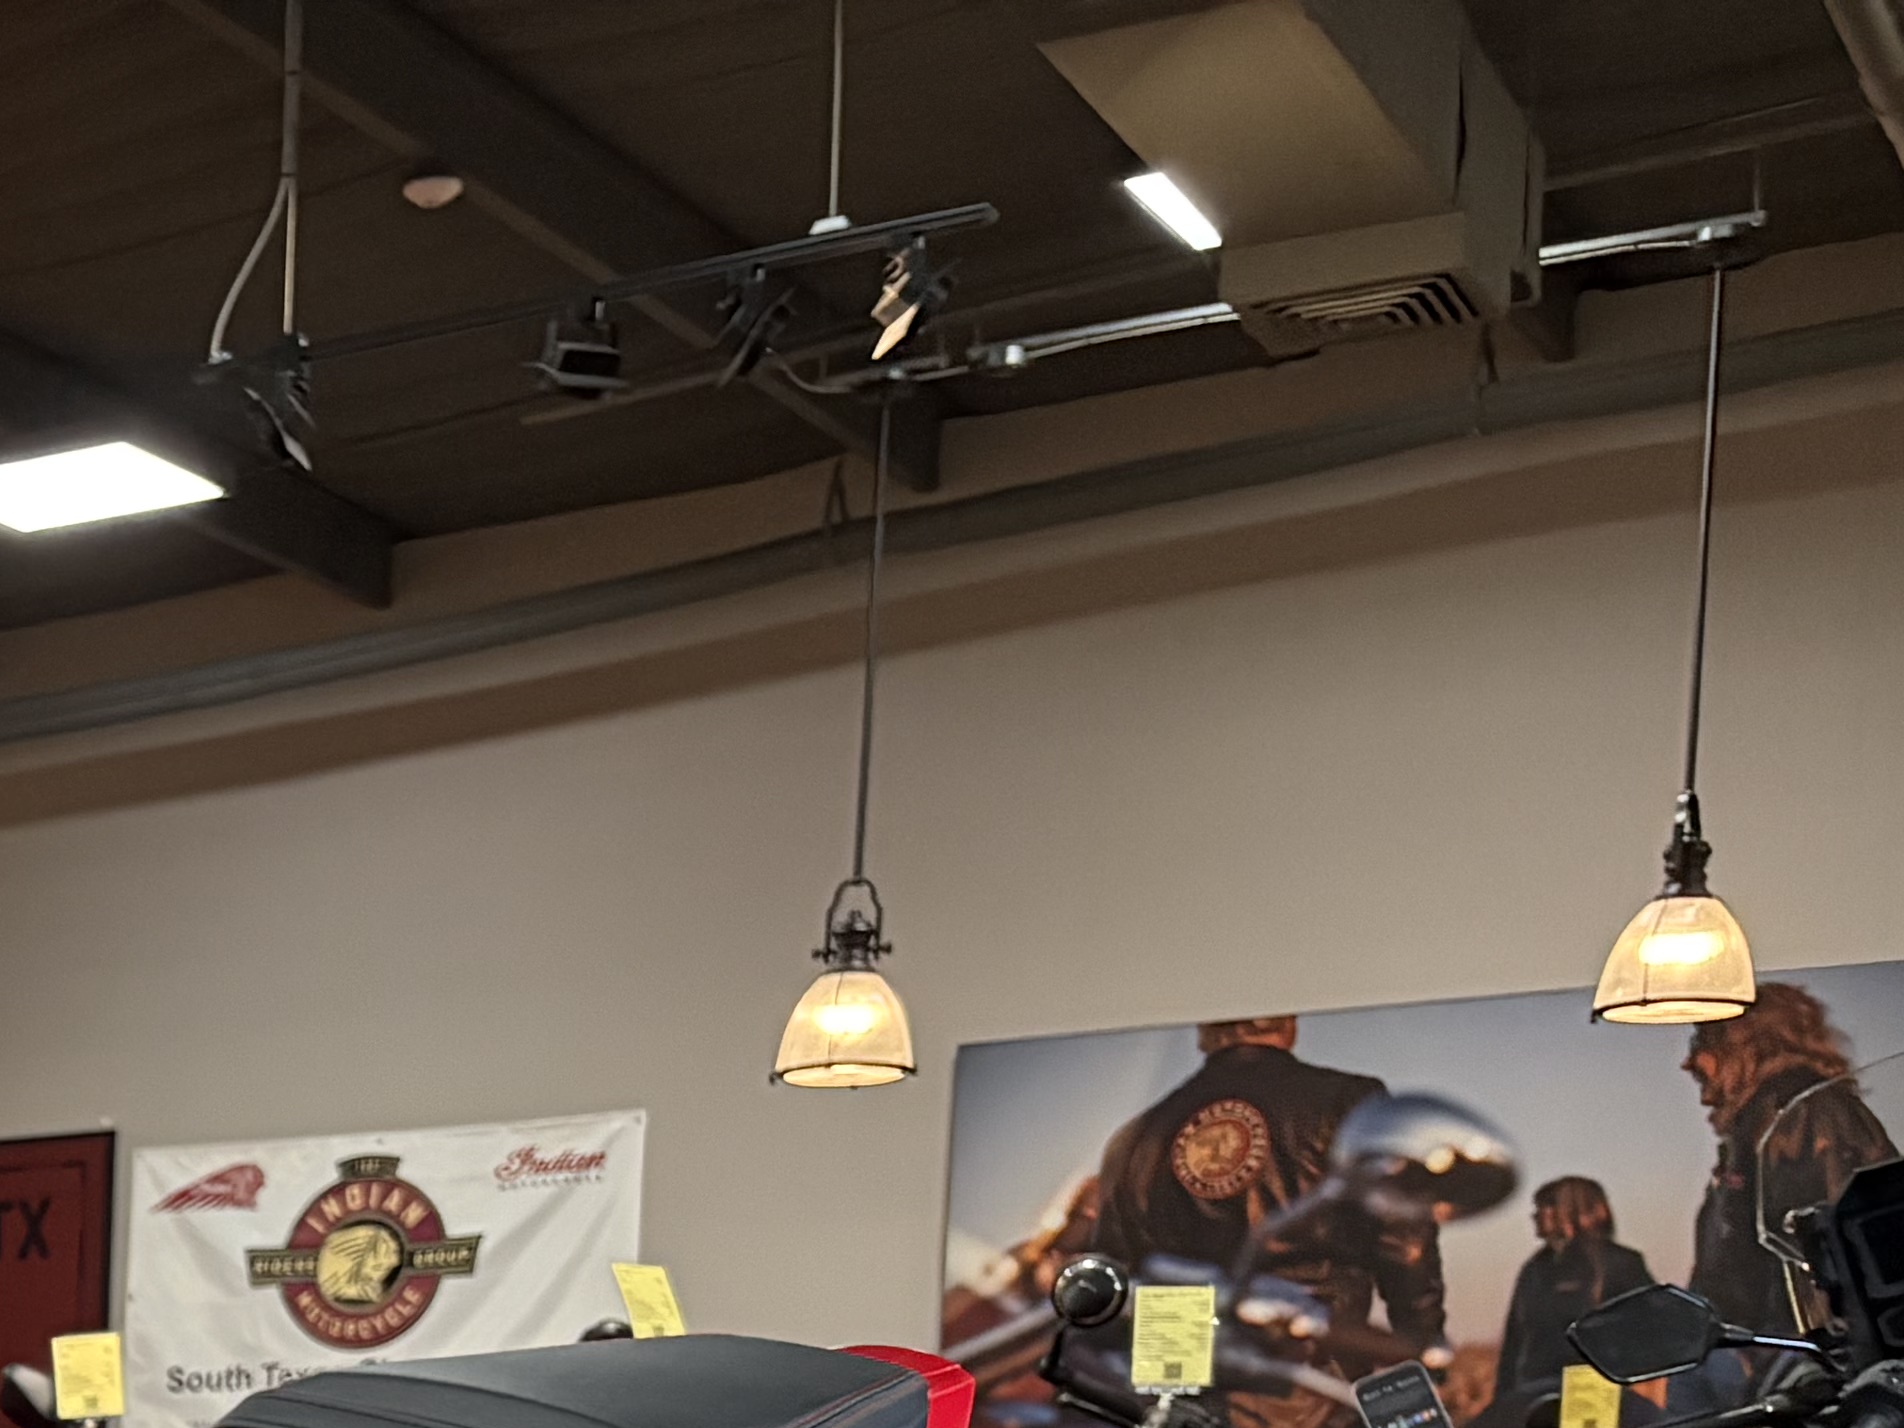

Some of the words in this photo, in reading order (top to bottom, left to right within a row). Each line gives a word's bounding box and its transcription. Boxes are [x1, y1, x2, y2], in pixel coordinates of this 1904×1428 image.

[306, 1181, 430, 1233] INDIAN
[252, 1257, 318, 1275] RIDERS
[412, 1248, 472, 1269] GROUP
[295, 1285, 422, 1340] MOTORCYCLE
[166, 1363, 252, 1394] South
